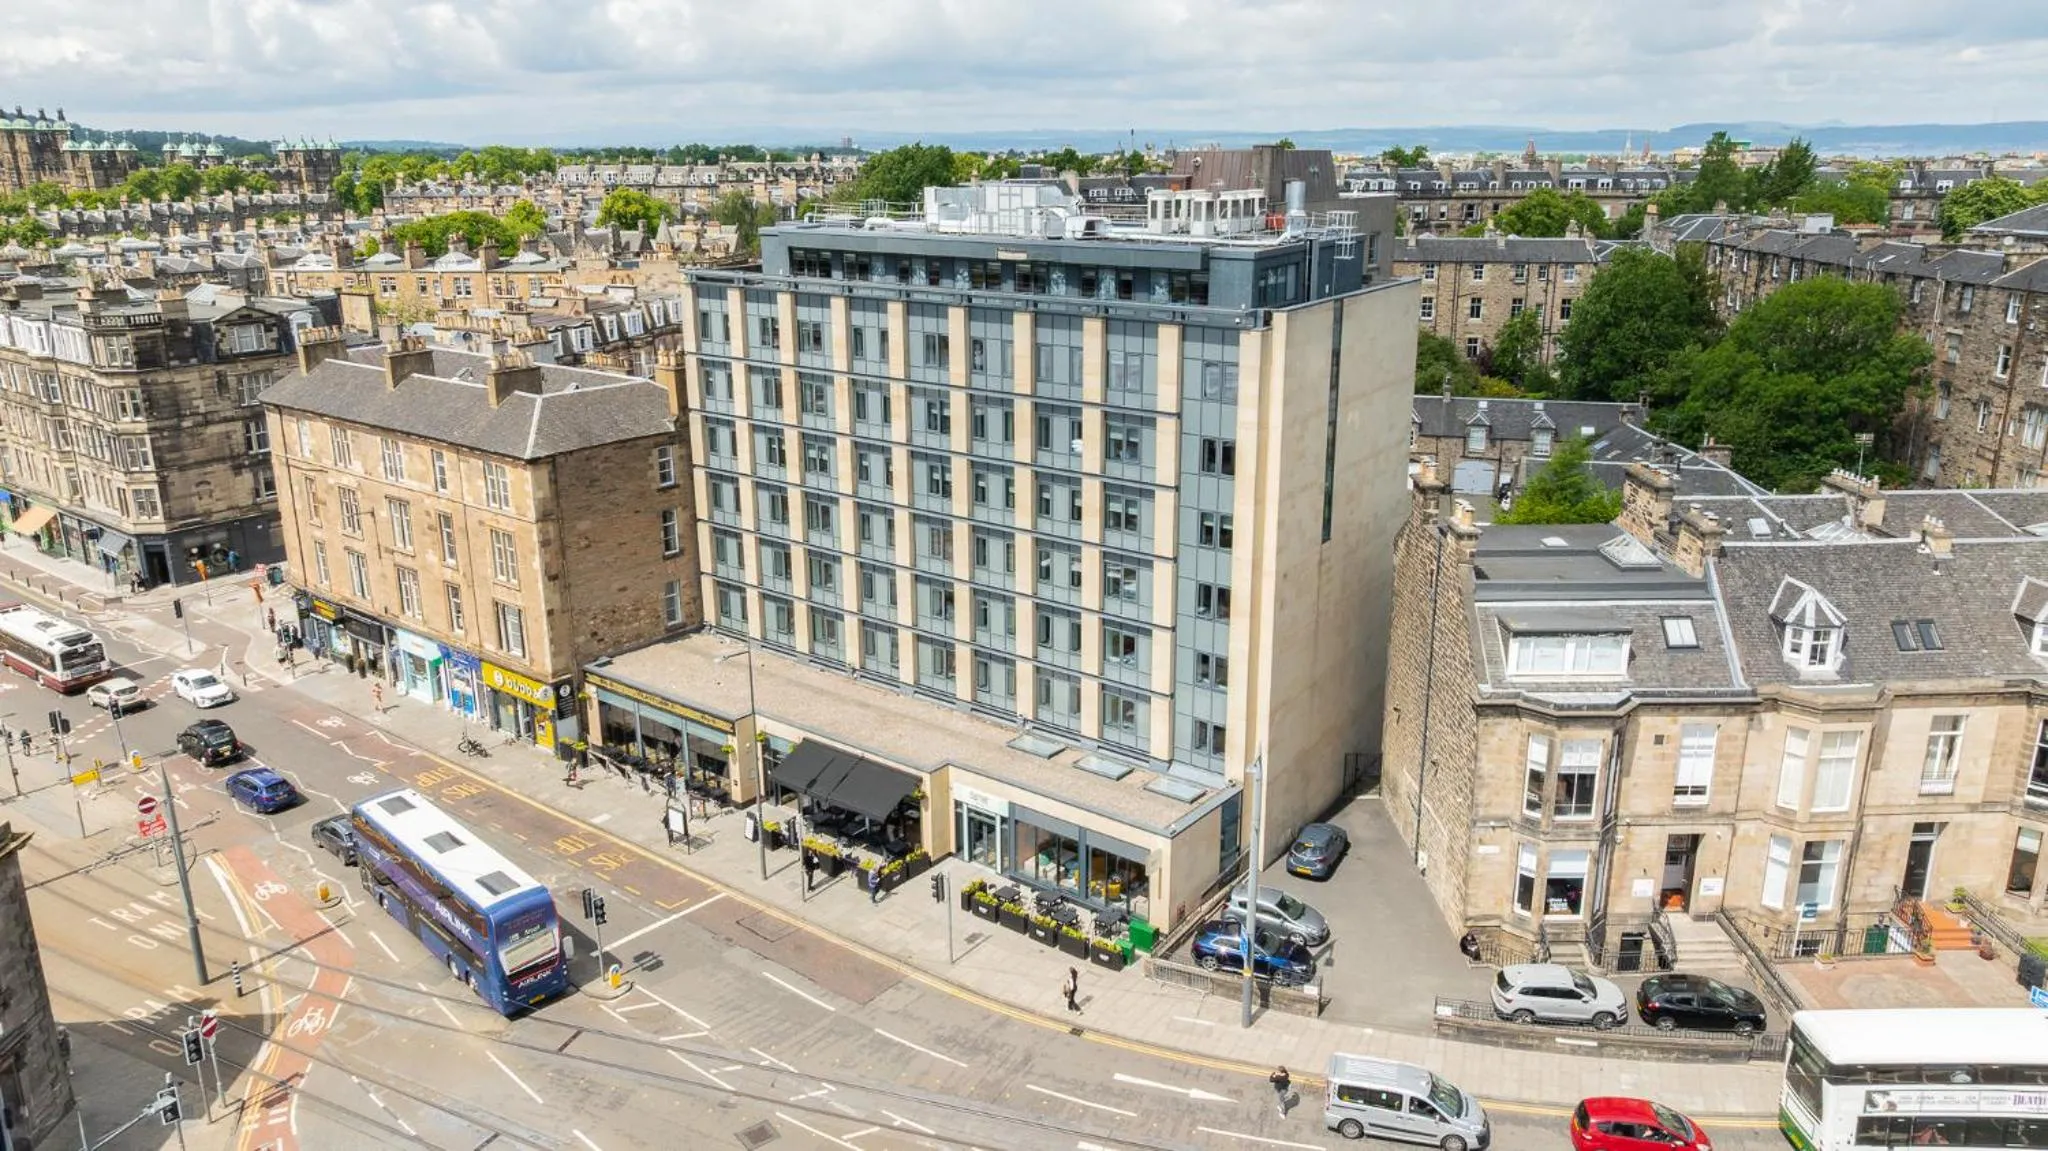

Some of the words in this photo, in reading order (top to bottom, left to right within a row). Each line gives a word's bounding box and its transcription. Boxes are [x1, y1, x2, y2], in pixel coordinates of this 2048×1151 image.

[87, 890, 181, 931] TRAM
[435, 901, 473, 941] AIRLINK
[518, 968, 553, 989] AIRLINK
[98, 985, 204, 1036] TRAM
